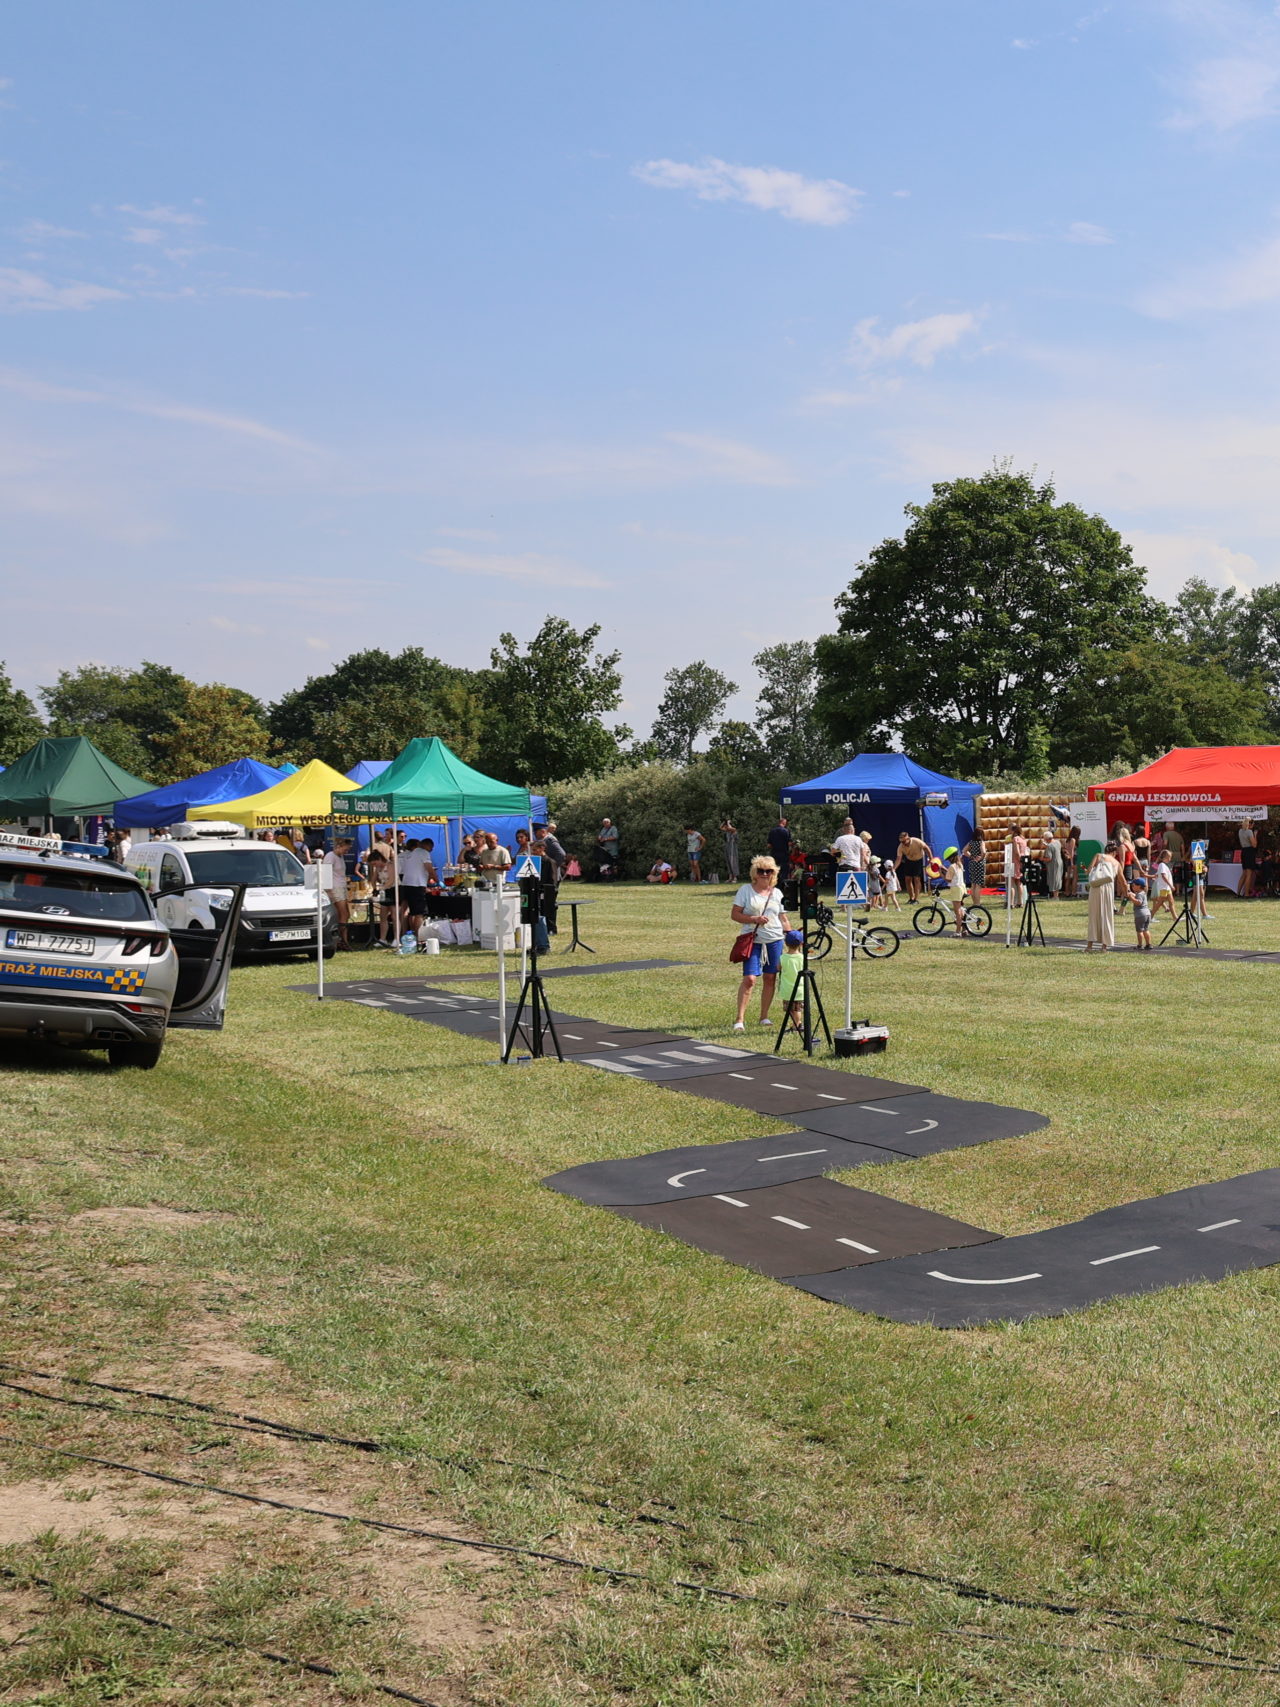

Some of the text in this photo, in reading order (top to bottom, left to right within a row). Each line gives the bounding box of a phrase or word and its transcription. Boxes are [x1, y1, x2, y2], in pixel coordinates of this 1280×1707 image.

[825, 793, 871, 803] POLICJA
[1108, 793, 1222, 802] GMINA LESZNOWOLA
[256, 815, 294, 826] MIODY
[17, 836, 59, 849] MIEJSKA
[49, 936, 92, 951] 7775J
[0, 962, 104, 981] TRAŻ MIEJSKA
